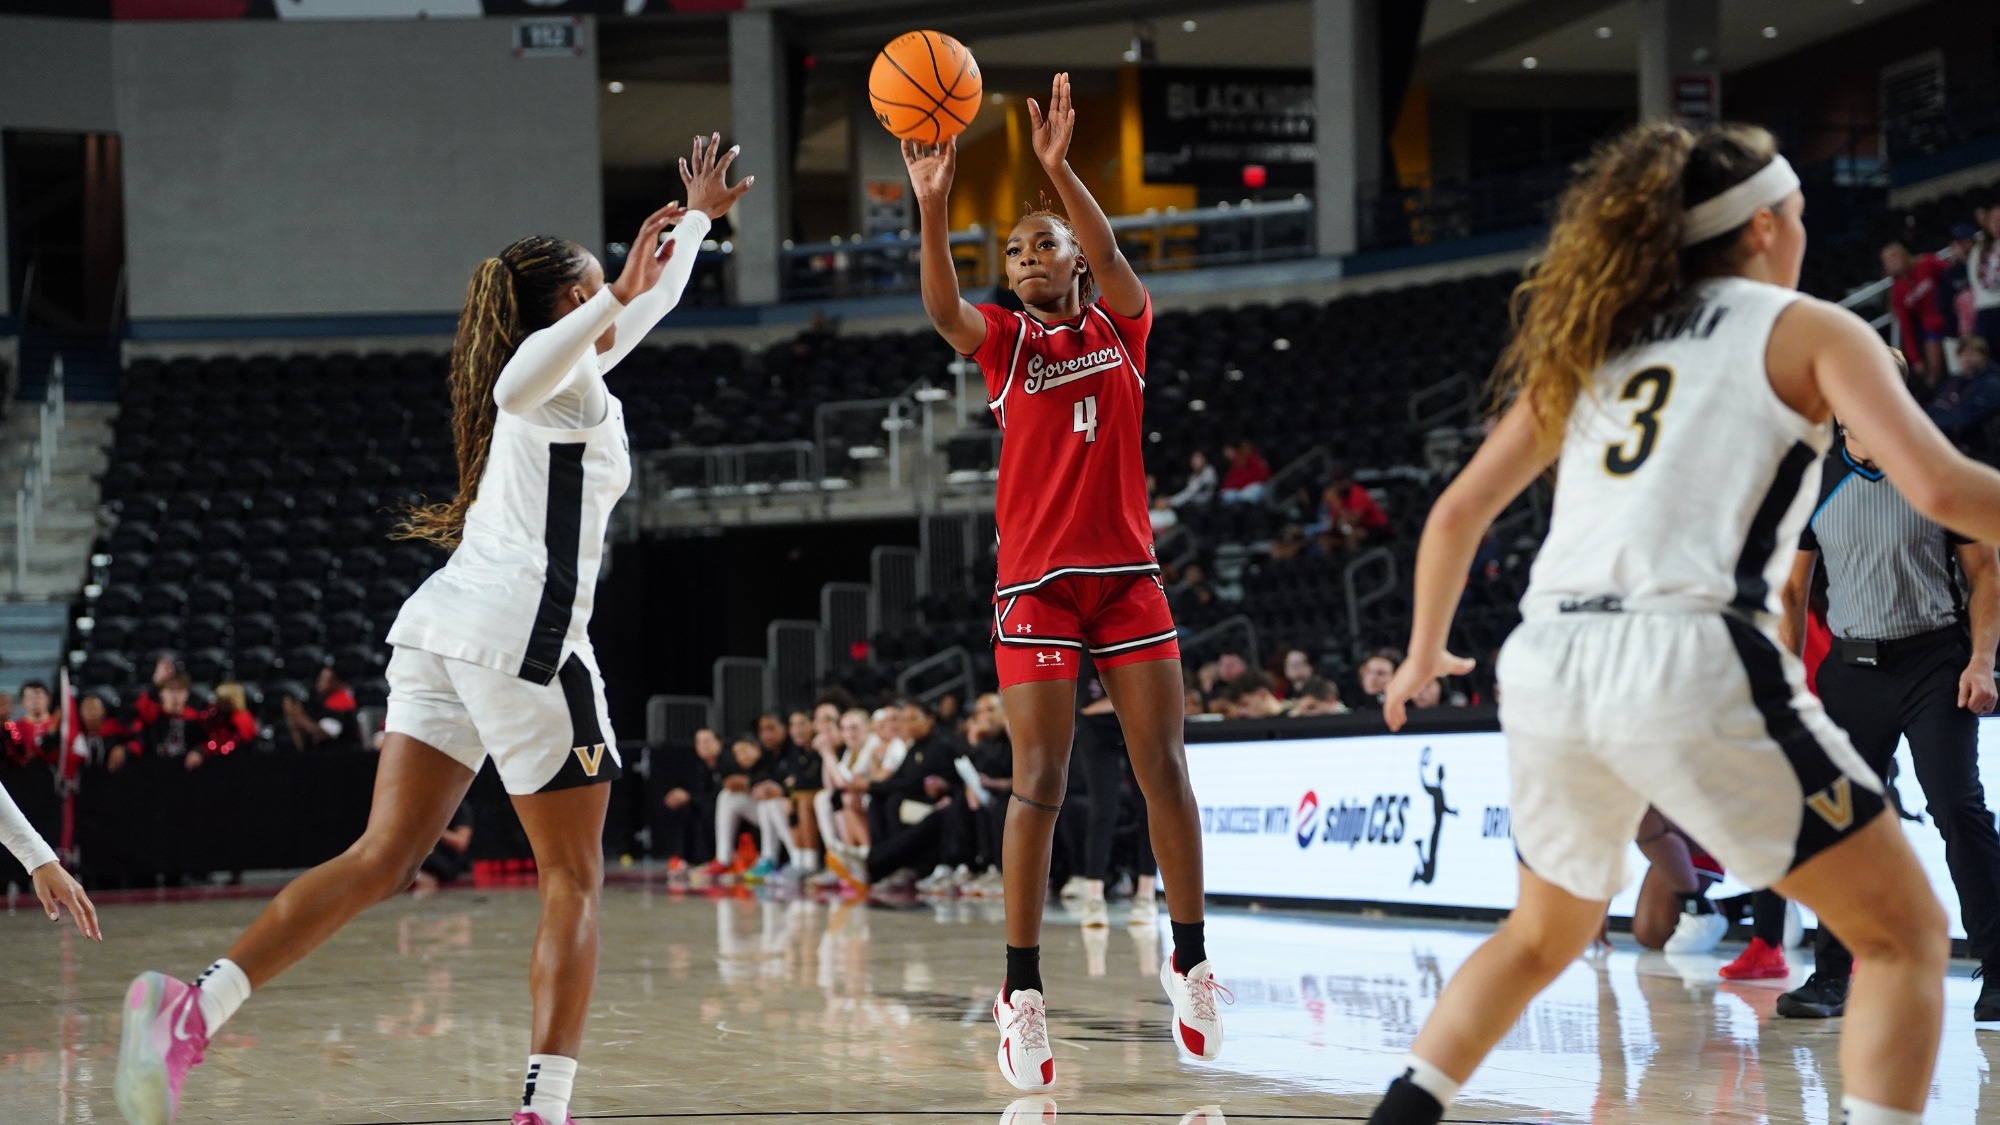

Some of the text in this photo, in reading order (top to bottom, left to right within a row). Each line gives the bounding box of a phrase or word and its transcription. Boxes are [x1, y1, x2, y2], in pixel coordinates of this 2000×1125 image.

[1073, 395, 1097, 443] 4
[1602, 365, 1675, 477] 3
[572, 742, 605, 777] V
[1806, 775, 1854, 832] V
